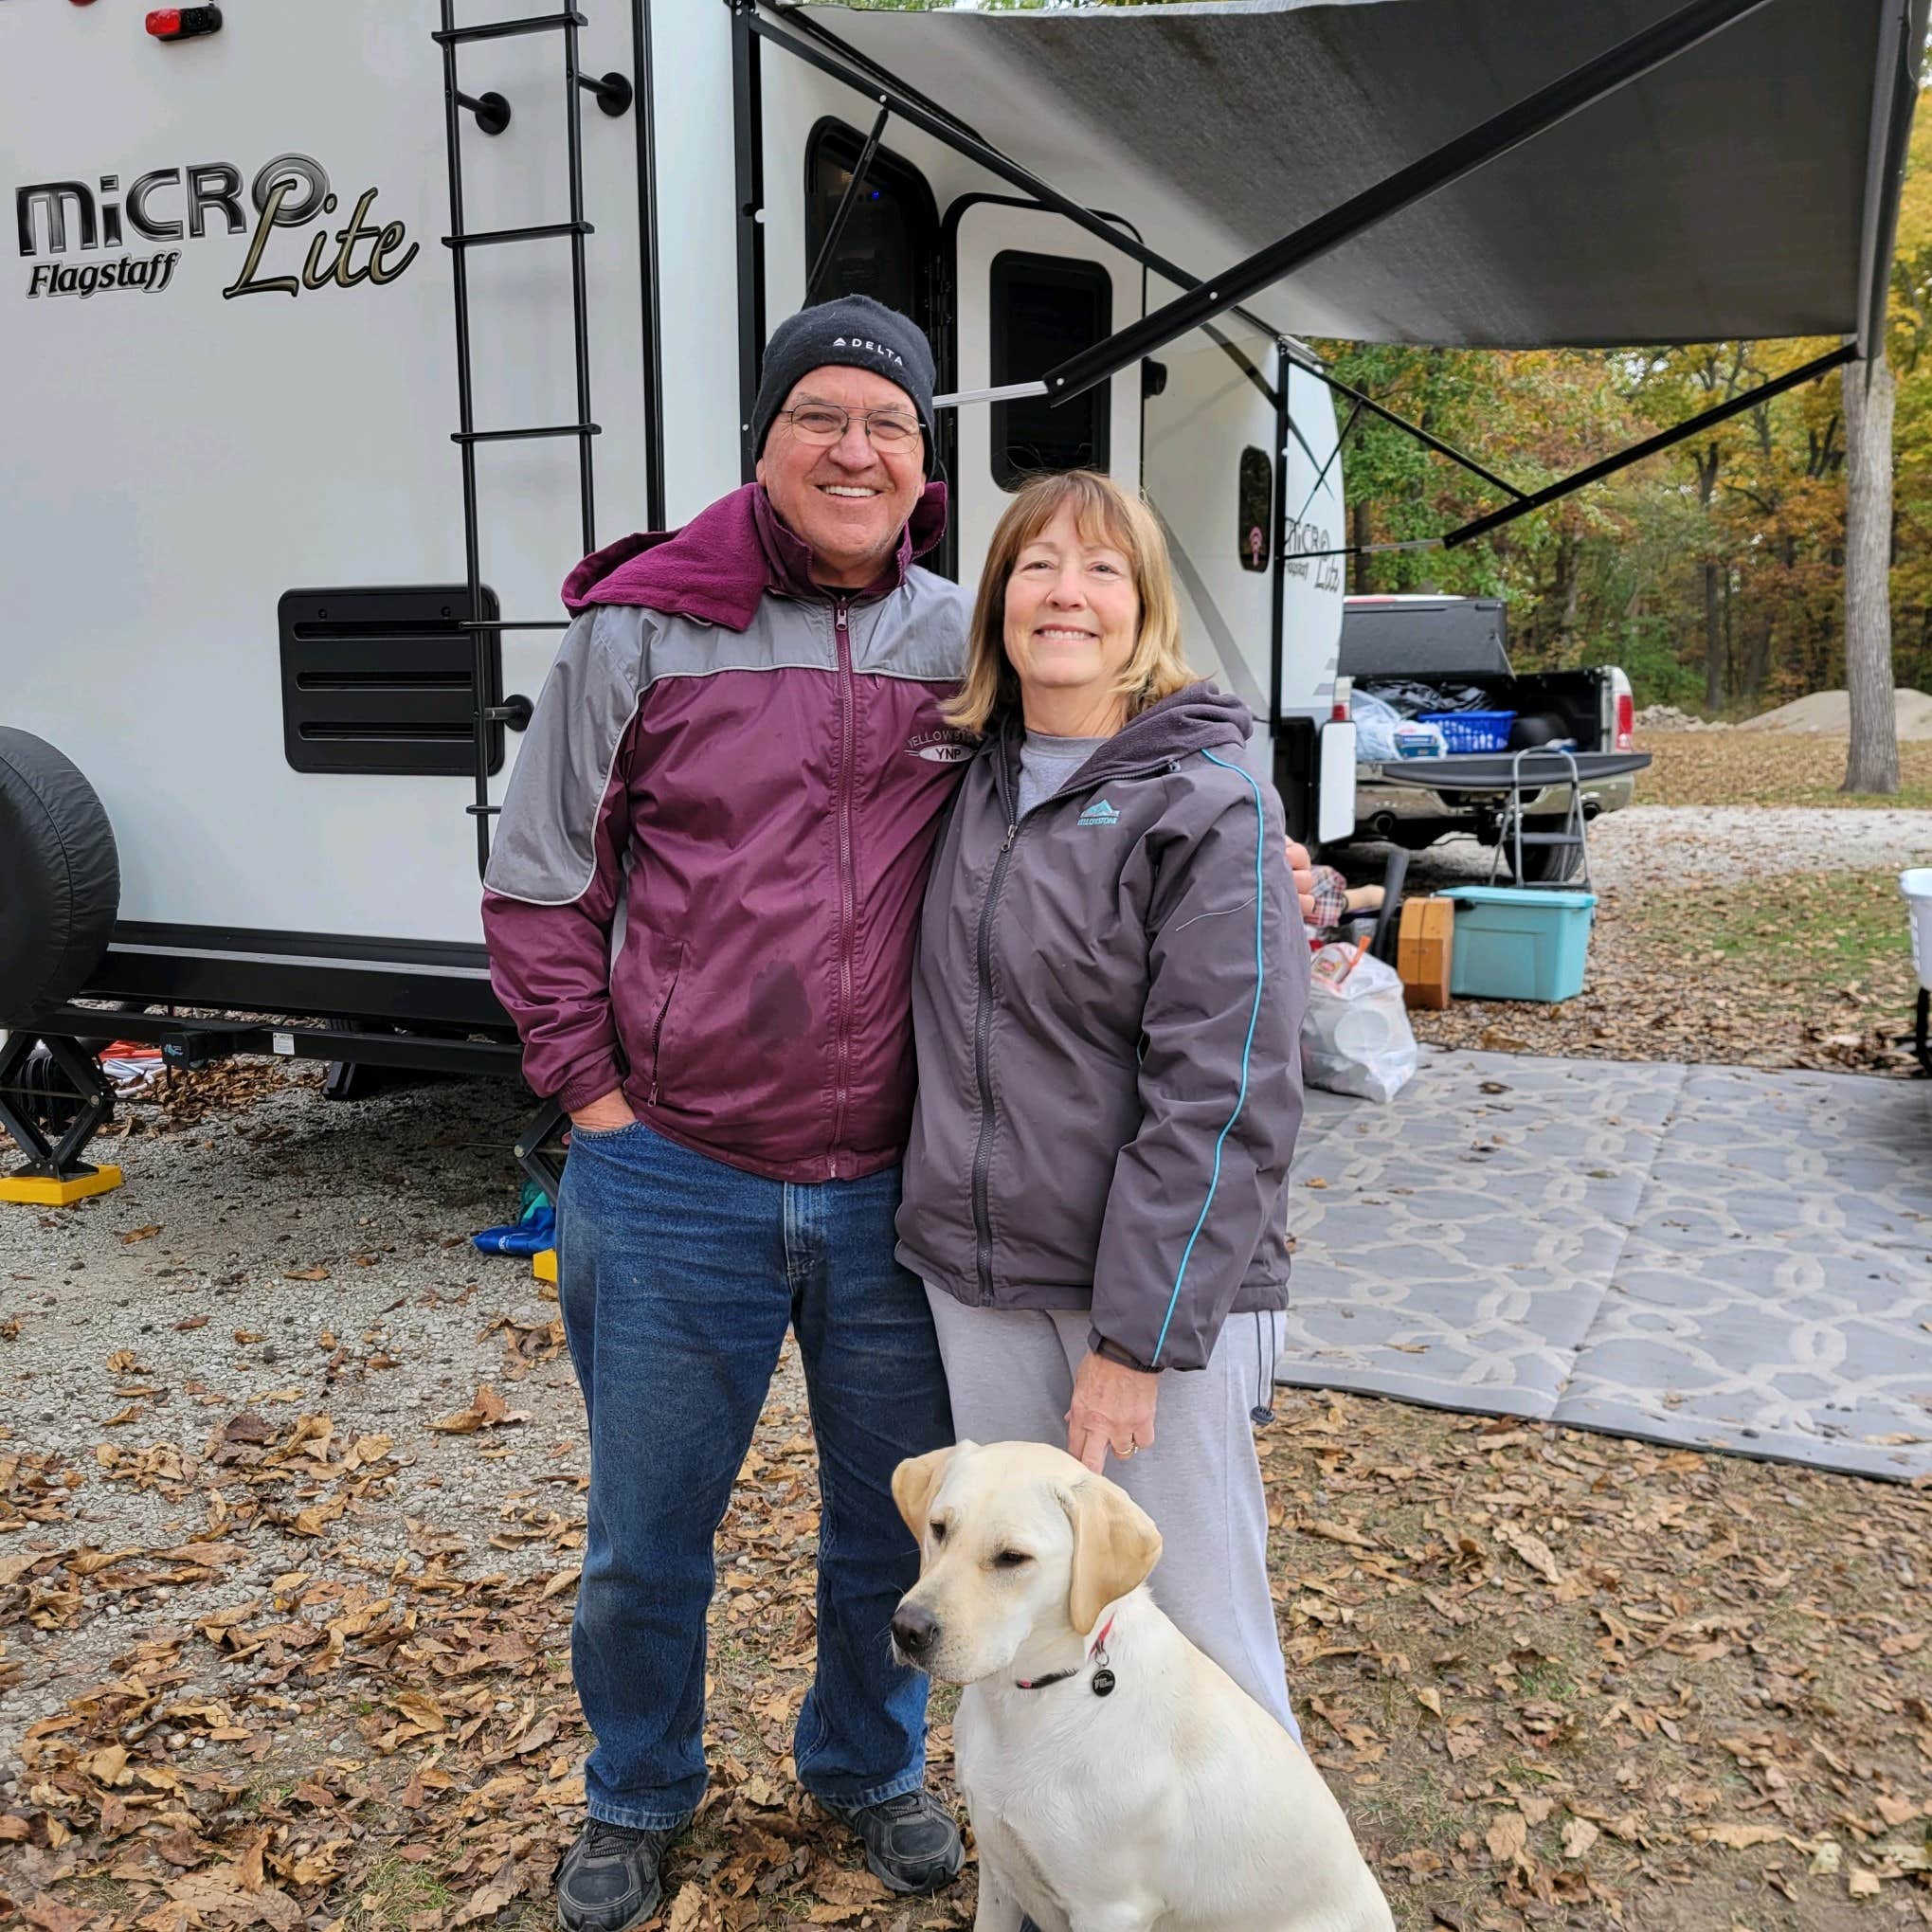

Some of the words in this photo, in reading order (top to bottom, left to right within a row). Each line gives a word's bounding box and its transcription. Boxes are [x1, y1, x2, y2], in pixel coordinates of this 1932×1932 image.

[222, 178, 419, 299] Lite
[27, 250, 181, 298] Flagstaff
[852, 338, 903, 367] DELTA
[935, 748, 961, 760] YNP
